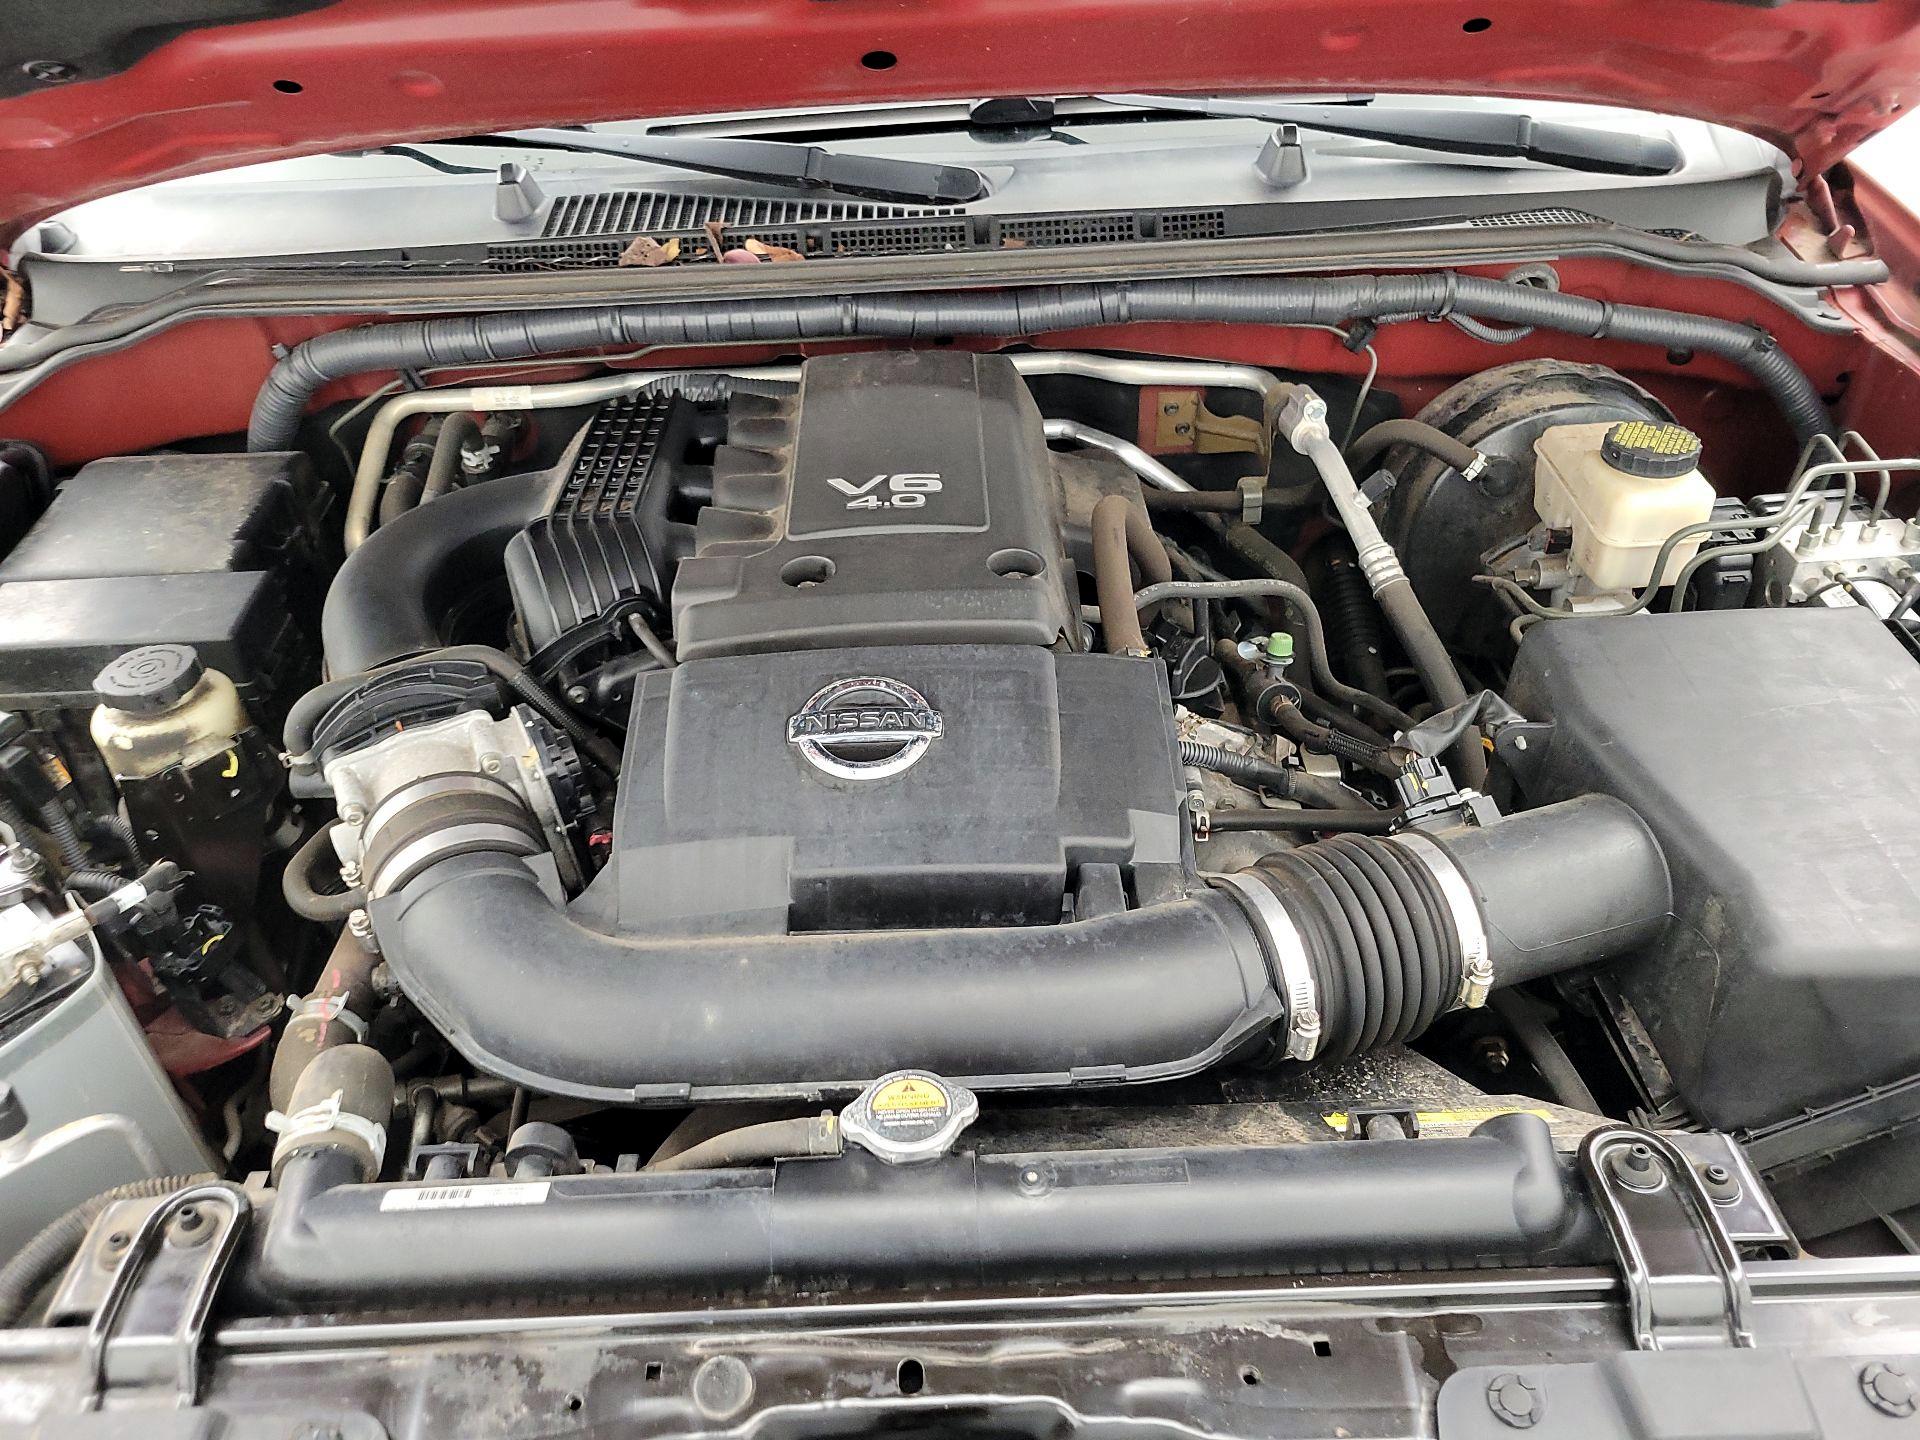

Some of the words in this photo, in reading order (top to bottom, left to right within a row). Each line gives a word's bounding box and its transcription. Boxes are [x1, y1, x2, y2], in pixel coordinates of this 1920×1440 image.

[826, 473, 943, 495] V6
[846, 493, 926, 510] 4.0
[804, 711, 927, 730] NISSAN
